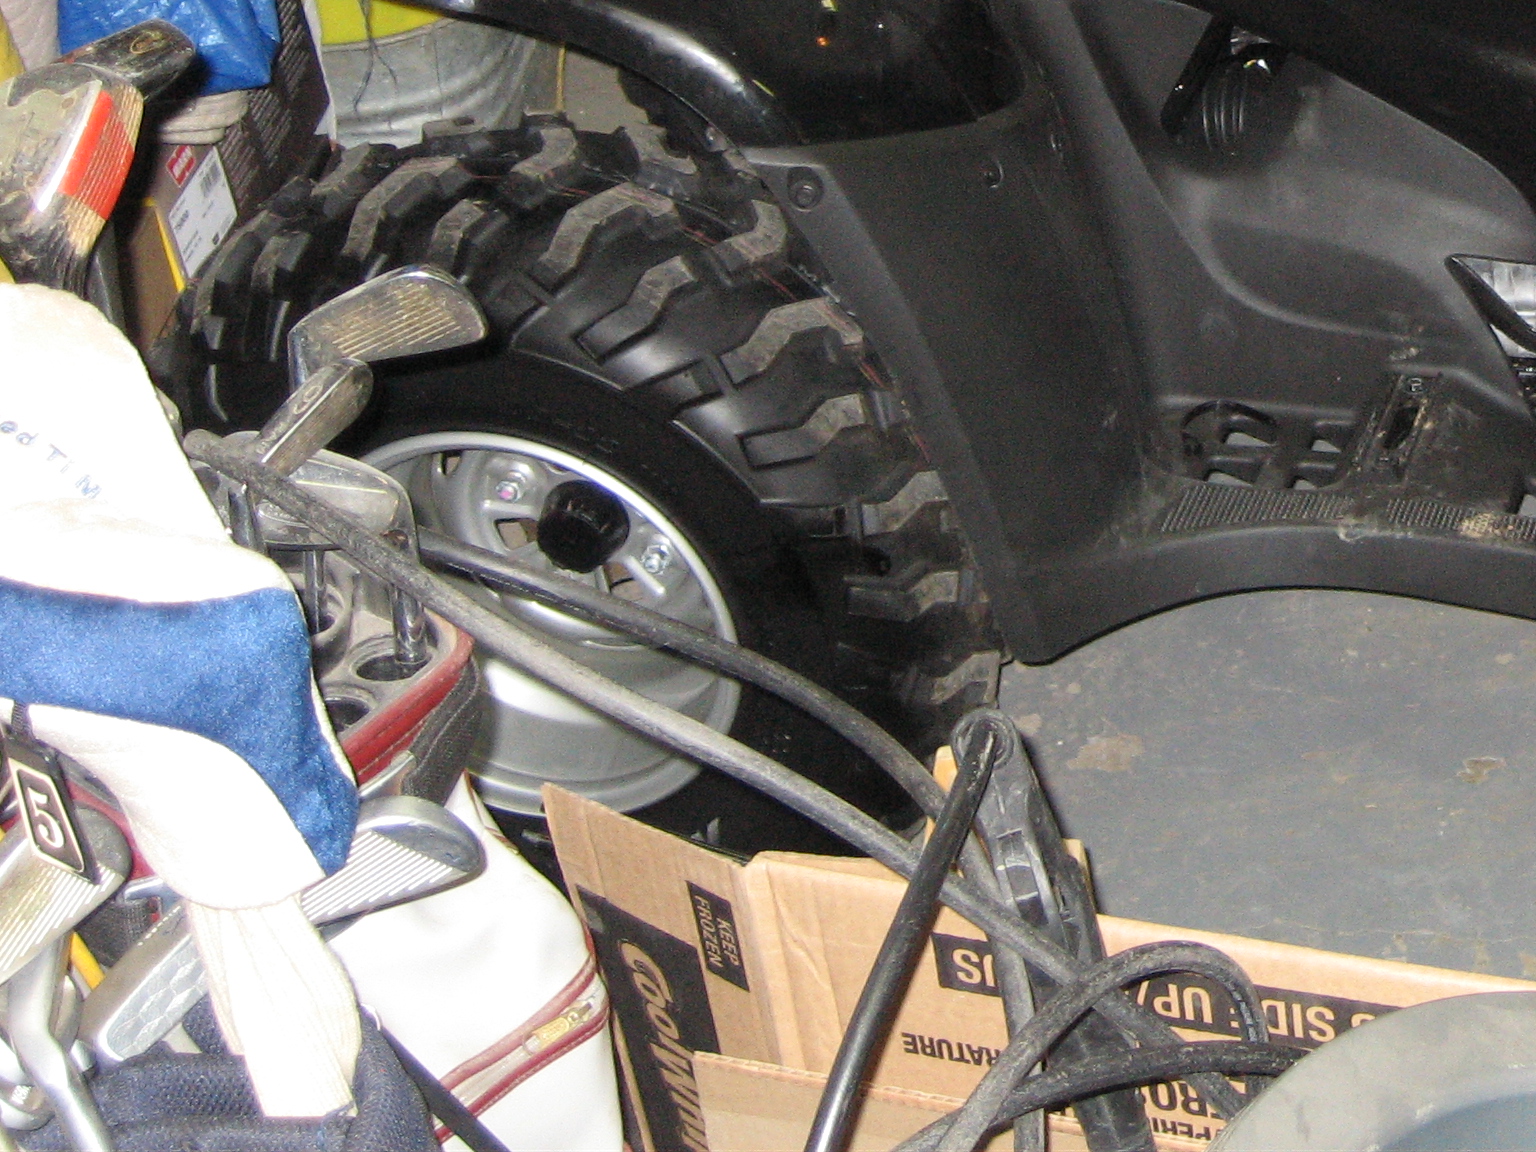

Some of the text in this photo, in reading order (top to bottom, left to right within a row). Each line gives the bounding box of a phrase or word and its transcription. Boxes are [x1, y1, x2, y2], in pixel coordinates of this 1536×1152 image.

[27, 786, 65, 848] 5
[695, 895, 723, 969] FROZEN
[717, 917, 740, 966] KEEP
[902, 1032, 1000, 1067] RATURE
